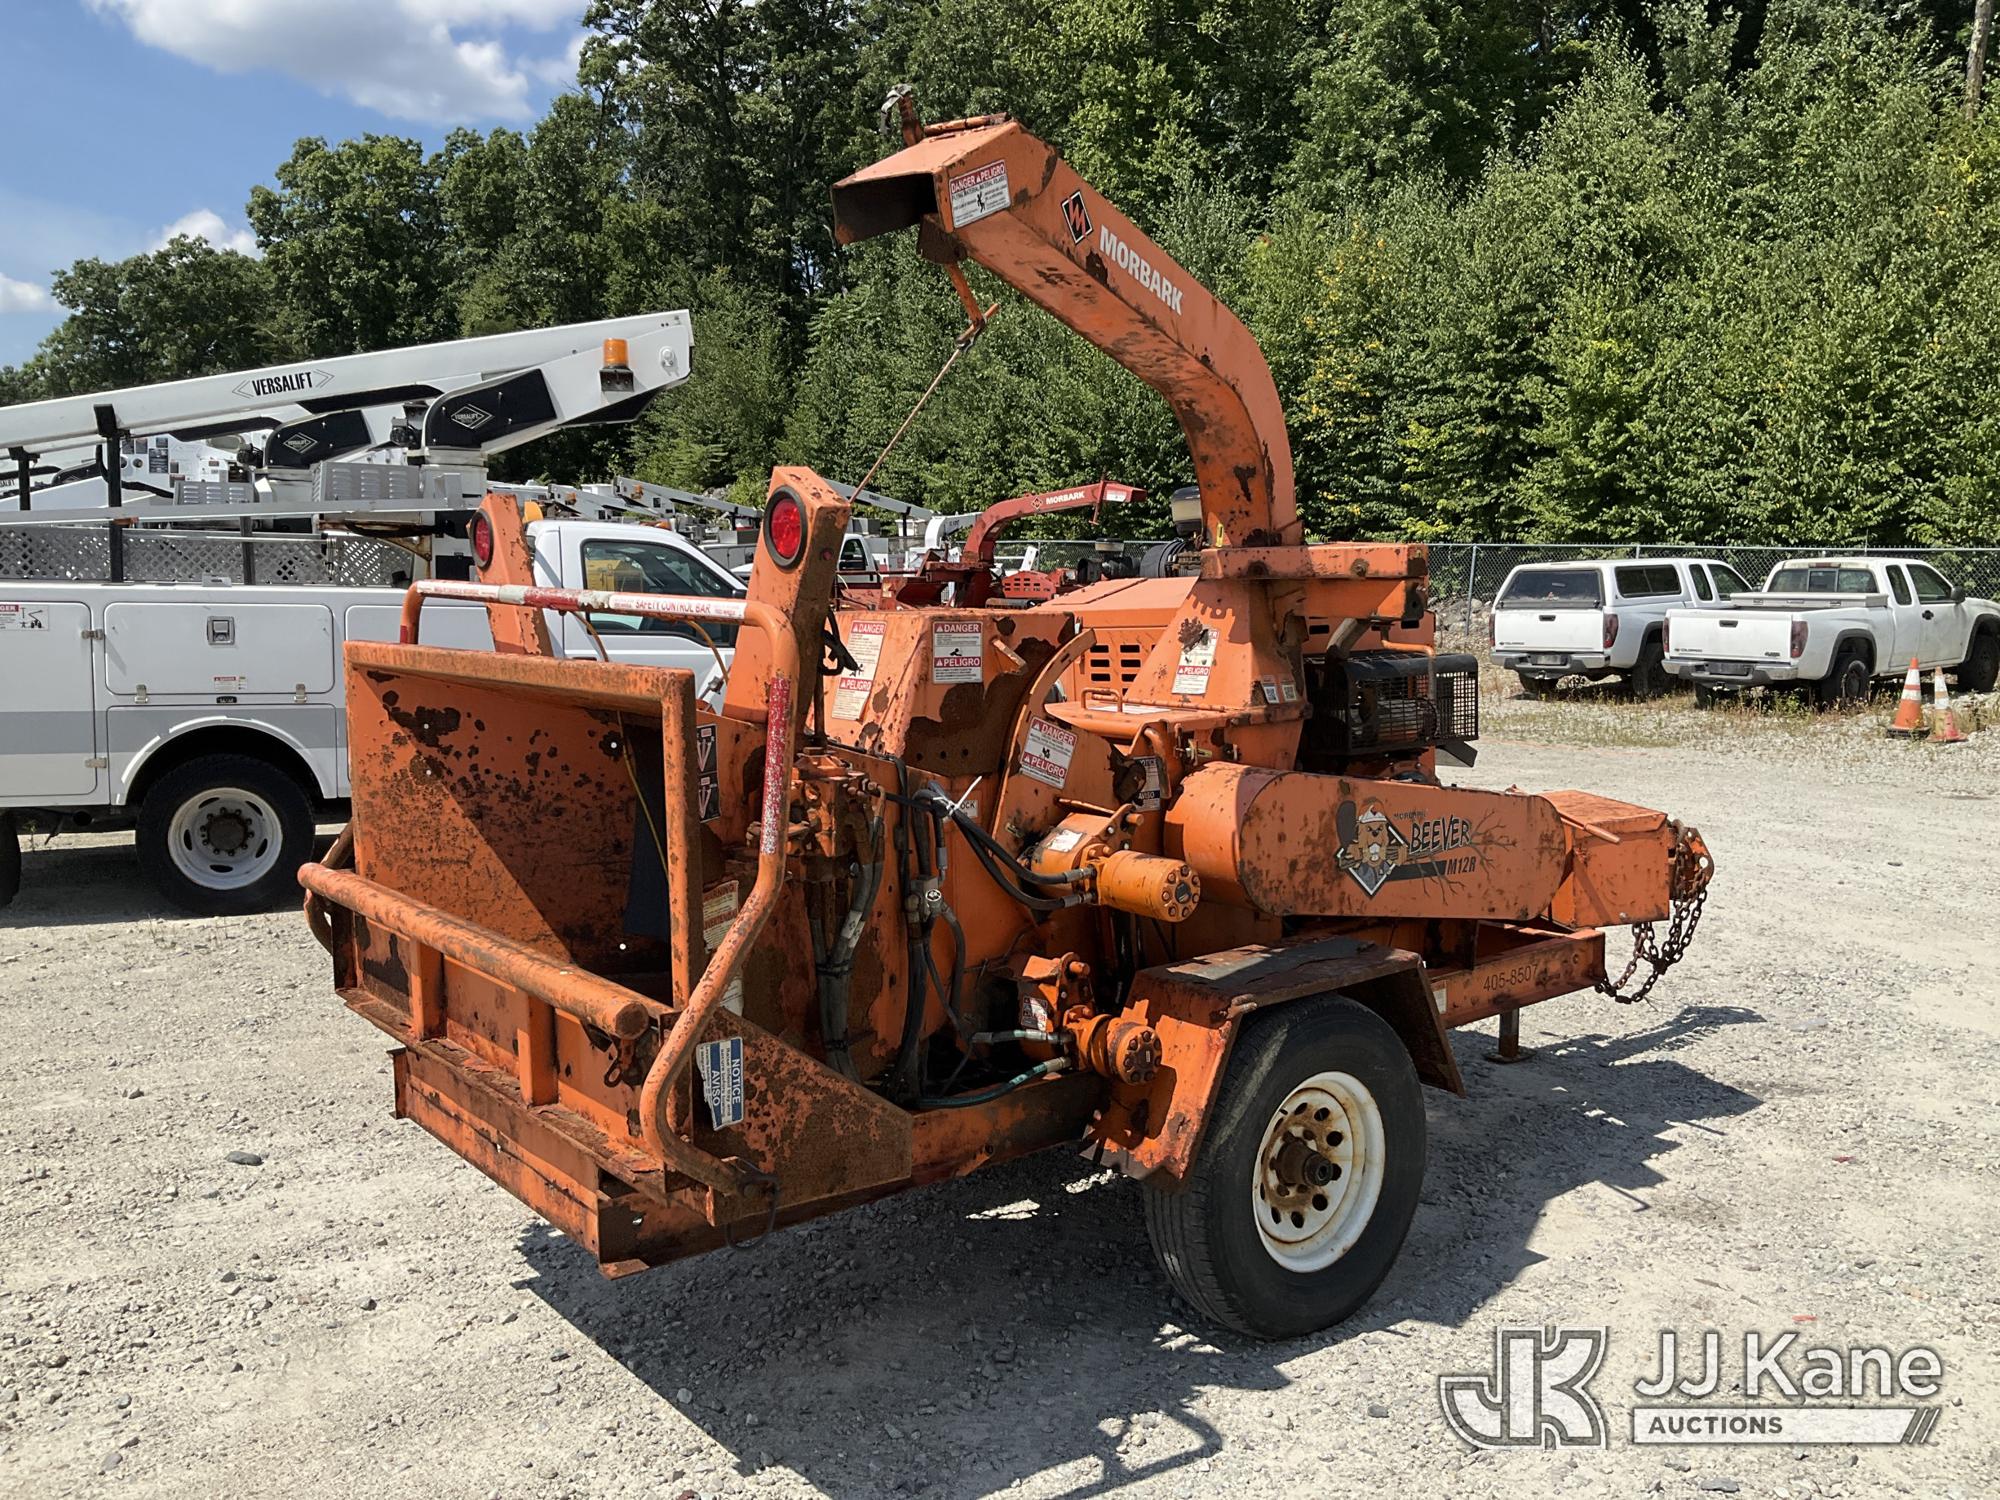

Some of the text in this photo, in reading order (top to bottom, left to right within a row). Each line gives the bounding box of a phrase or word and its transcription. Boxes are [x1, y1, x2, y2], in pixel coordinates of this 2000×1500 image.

[951, 176, 976, 193] DANGER
[981, 164, 1005, 181] PELIGRO
[1100, 224, 1183, 316] MORBARK
[252, 371, 313, 396] VERSALIFT
[1045, 490, 1085, 505] MORBARK
[635, 601, 660, 611] SAFETY
[661, 602, 694, 613] CONTROL
[695, 604, 711, 614] BAR
[859, 623, 885, 634] DANGER
[943, 624, 979, 633] DANGER
[943, 657, 980, 667] PELIGRO
[1183, 666, 1209, 675] PELIGRO
[844, 680, 872, 691] PELIGRO
[1041, 723, 1074, 745] DANGER
[1030, 756, 1065, 778] PELIGRO
[1409, 814, 1471, 854] BEEVER
[1446, 856, 1477, 876] M12R
[1483, 963, 1539, 992] 405-8507
[711, 1070, 721, 1106] AVISO
[732, 1058, 741, 1105] NOTICE
